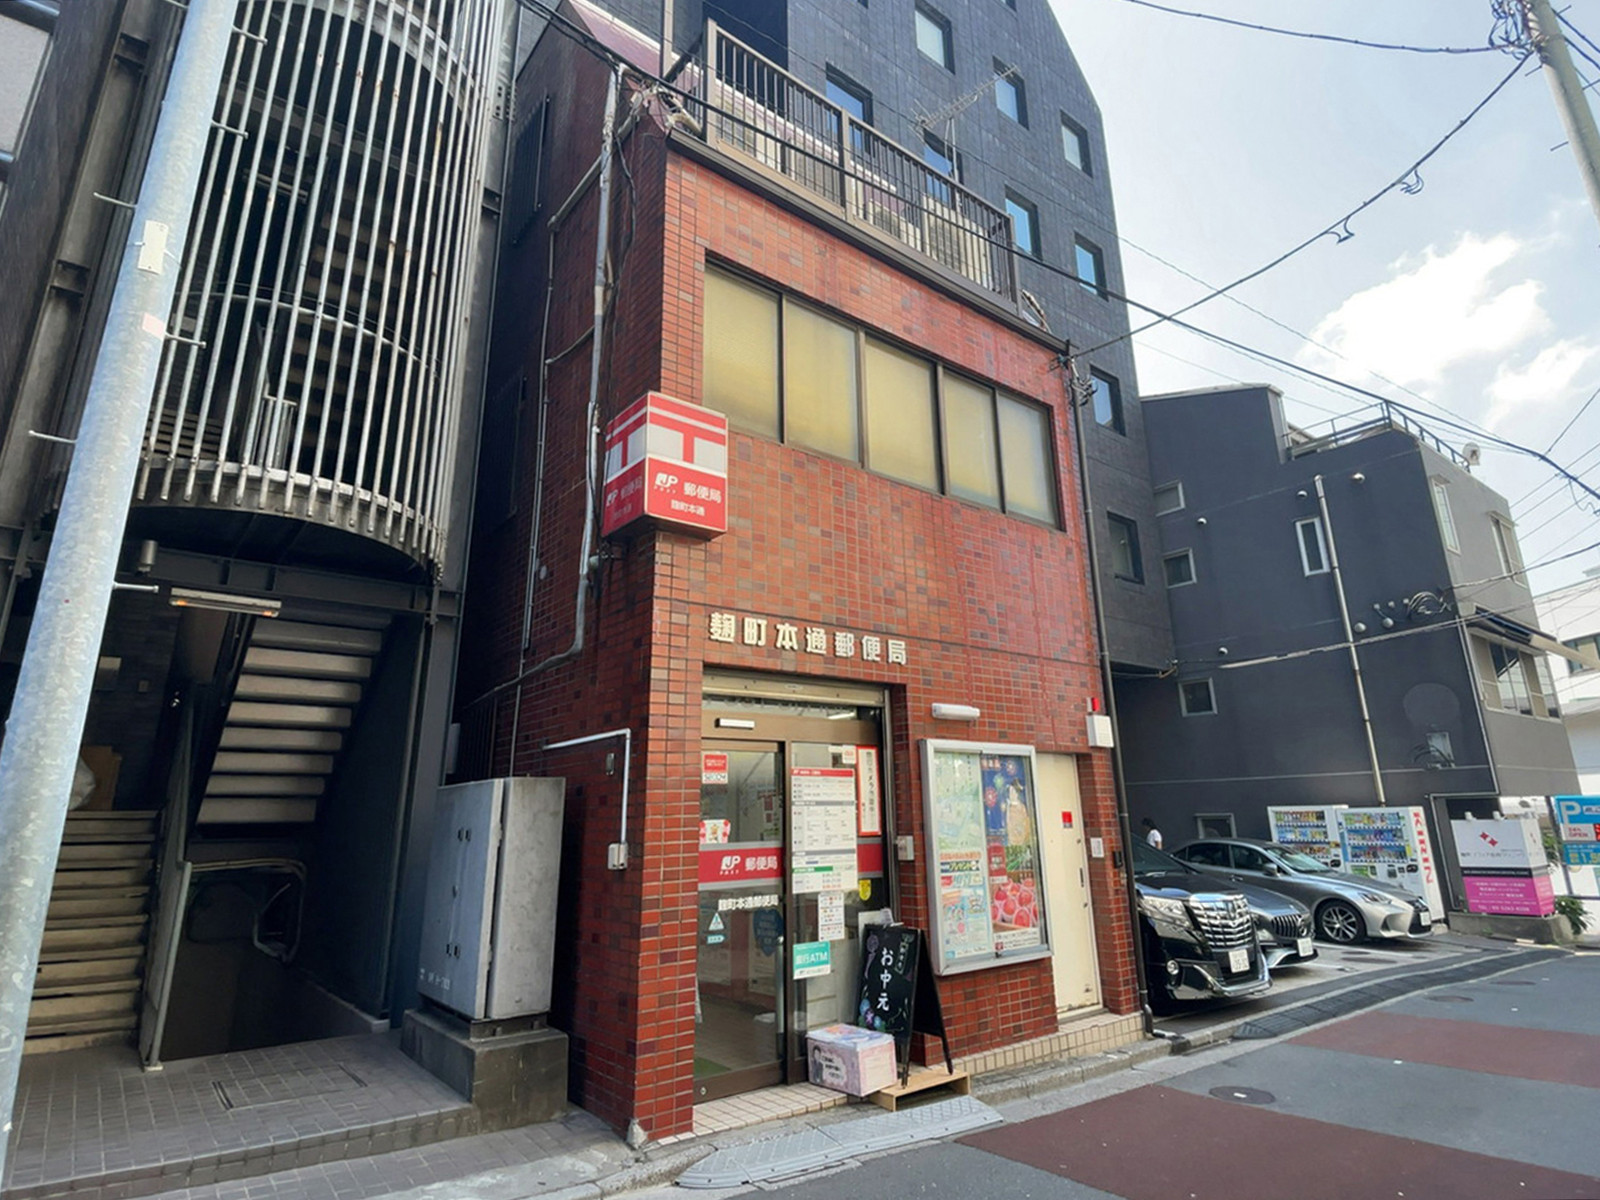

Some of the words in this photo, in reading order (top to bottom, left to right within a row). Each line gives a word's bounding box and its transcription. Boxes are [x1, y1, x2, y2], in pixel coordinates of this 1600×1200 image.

[684, 482, 722, 504] 郵便局
[709, 612, 907, 665] 麹町本通郵便局
[744, 855, 778, 872] 郵便局
[876, 947, 894, 1011] お中元
